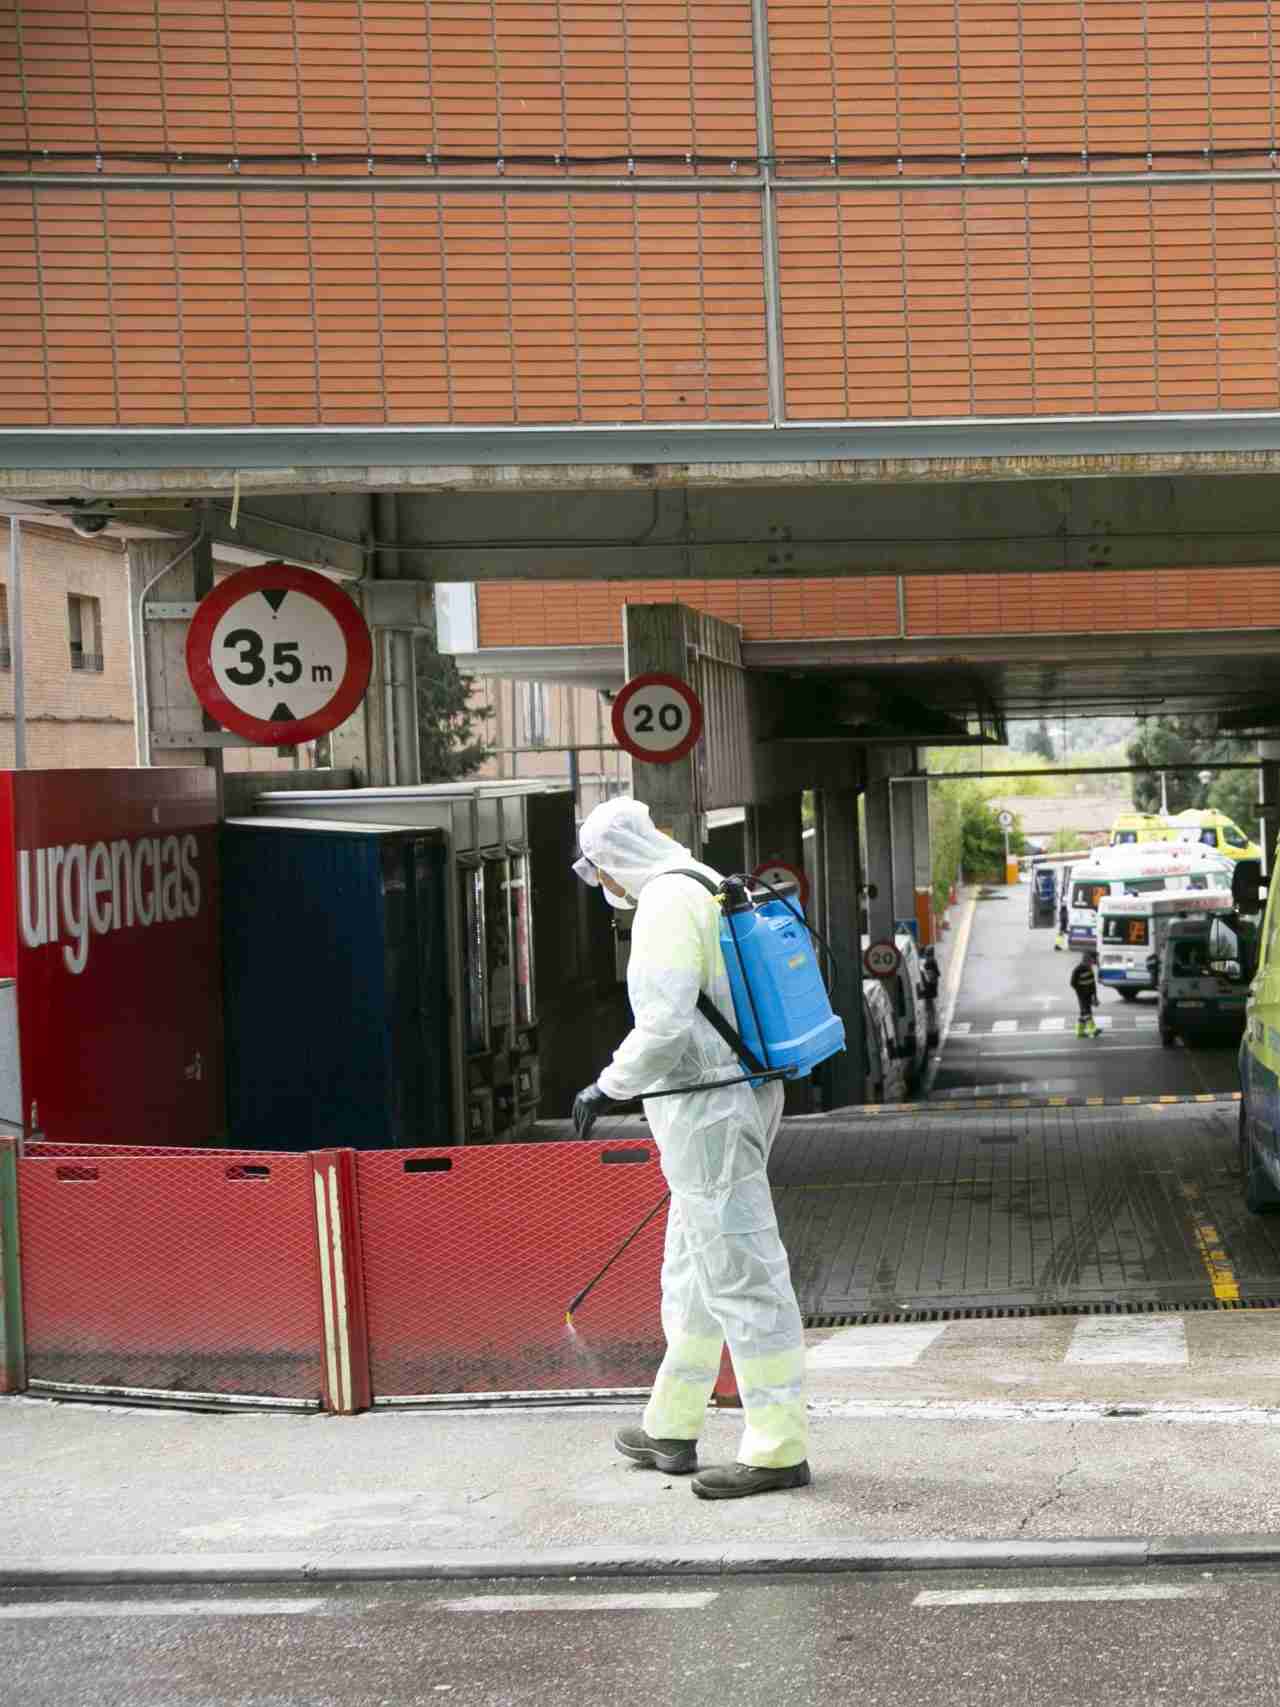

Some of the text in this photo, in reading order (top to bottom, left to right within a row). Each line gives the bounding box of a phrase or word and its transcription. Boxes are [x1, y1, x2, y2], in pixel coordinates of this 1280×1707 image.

[223, 629, 332, 688] 3,5 m
[633, 703, 682, 732] 20
[19, 834, 200, 974] urgencias
[872, 952, 893, 965] 20
